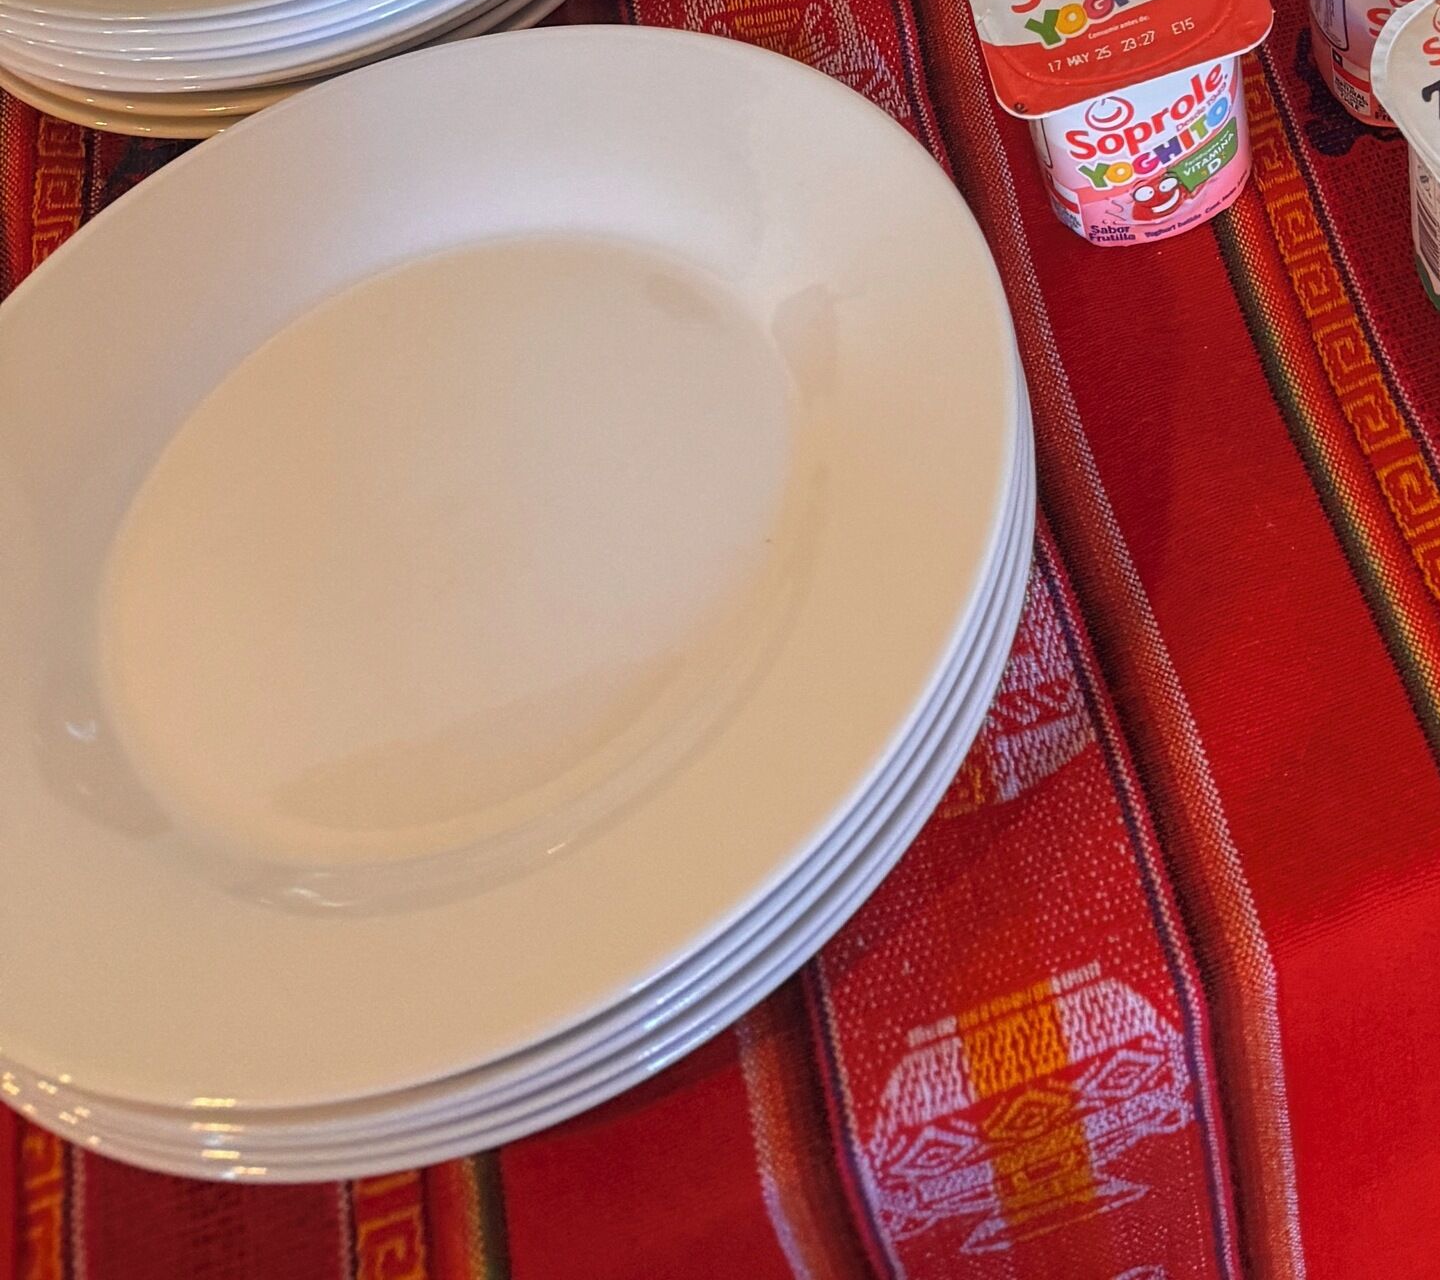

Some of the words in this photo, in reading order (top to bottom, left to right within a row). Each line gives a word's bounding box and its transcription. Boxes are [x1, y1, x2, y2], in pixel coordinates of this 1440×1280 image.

[1048, 59, 1062, 73] 17
[1066, 52, 1090, 67] MAY
[1094, 45, 1112, 60] 25
[1120, 30, 1155, 52] 23:27
[1171, 17, 1195, 35] E15
[1065, 63, 1223, 160] Soprole
[1078, 96, 1229, 189] YOGHITO
[1183, 132, 1235, 176] VITAMINA
[1207, 158, 1221, 175] D
[1089, 233, 1136, 242] Frutilla
[1090, 225, 1130, 236] Sabor
